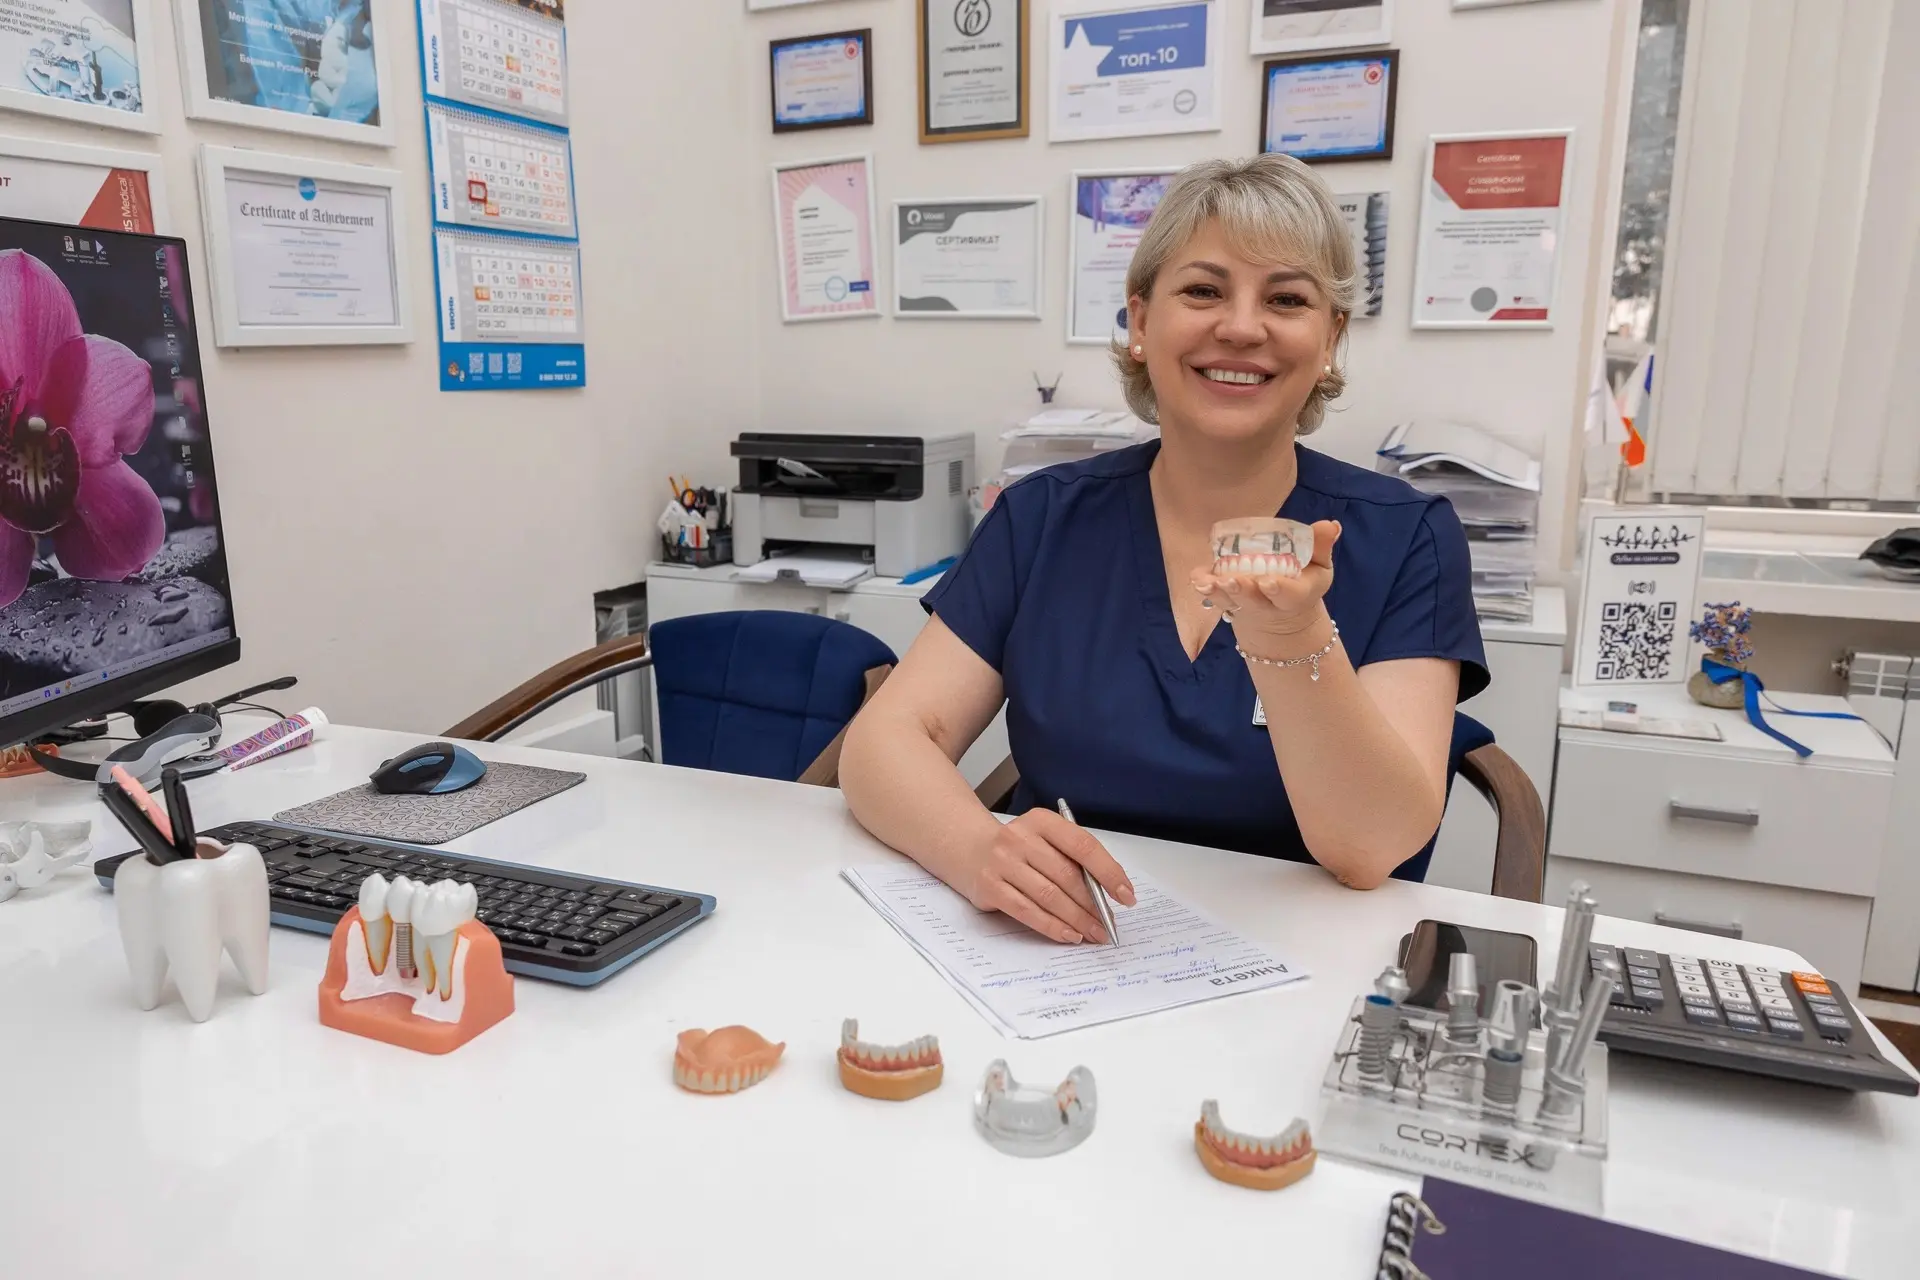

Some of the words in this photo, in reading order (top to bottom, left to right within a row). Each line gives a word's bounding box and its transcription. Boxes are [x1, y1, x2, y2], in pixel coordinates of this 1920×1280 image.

[23, 14, 46, 23] ПРИМЕРЕ
[229, 11, 282, 31] Методология
[432, 34, 440, 82] АПРЕЛЬ
[118, 178, 132, 218] Medical
[240, 202, 297, 221] Certificate
[299, 208, 309, 222] of
[312, 208, 374, 227] Achievement
[936, 235, 1000, 246] СЕРТИФИКАТ
[1210, 964, 1288, 986] Анкета
[1397, 1124, 1537, 1168] CORTEX
[1453, 1161, 1492, 1178] Dental
